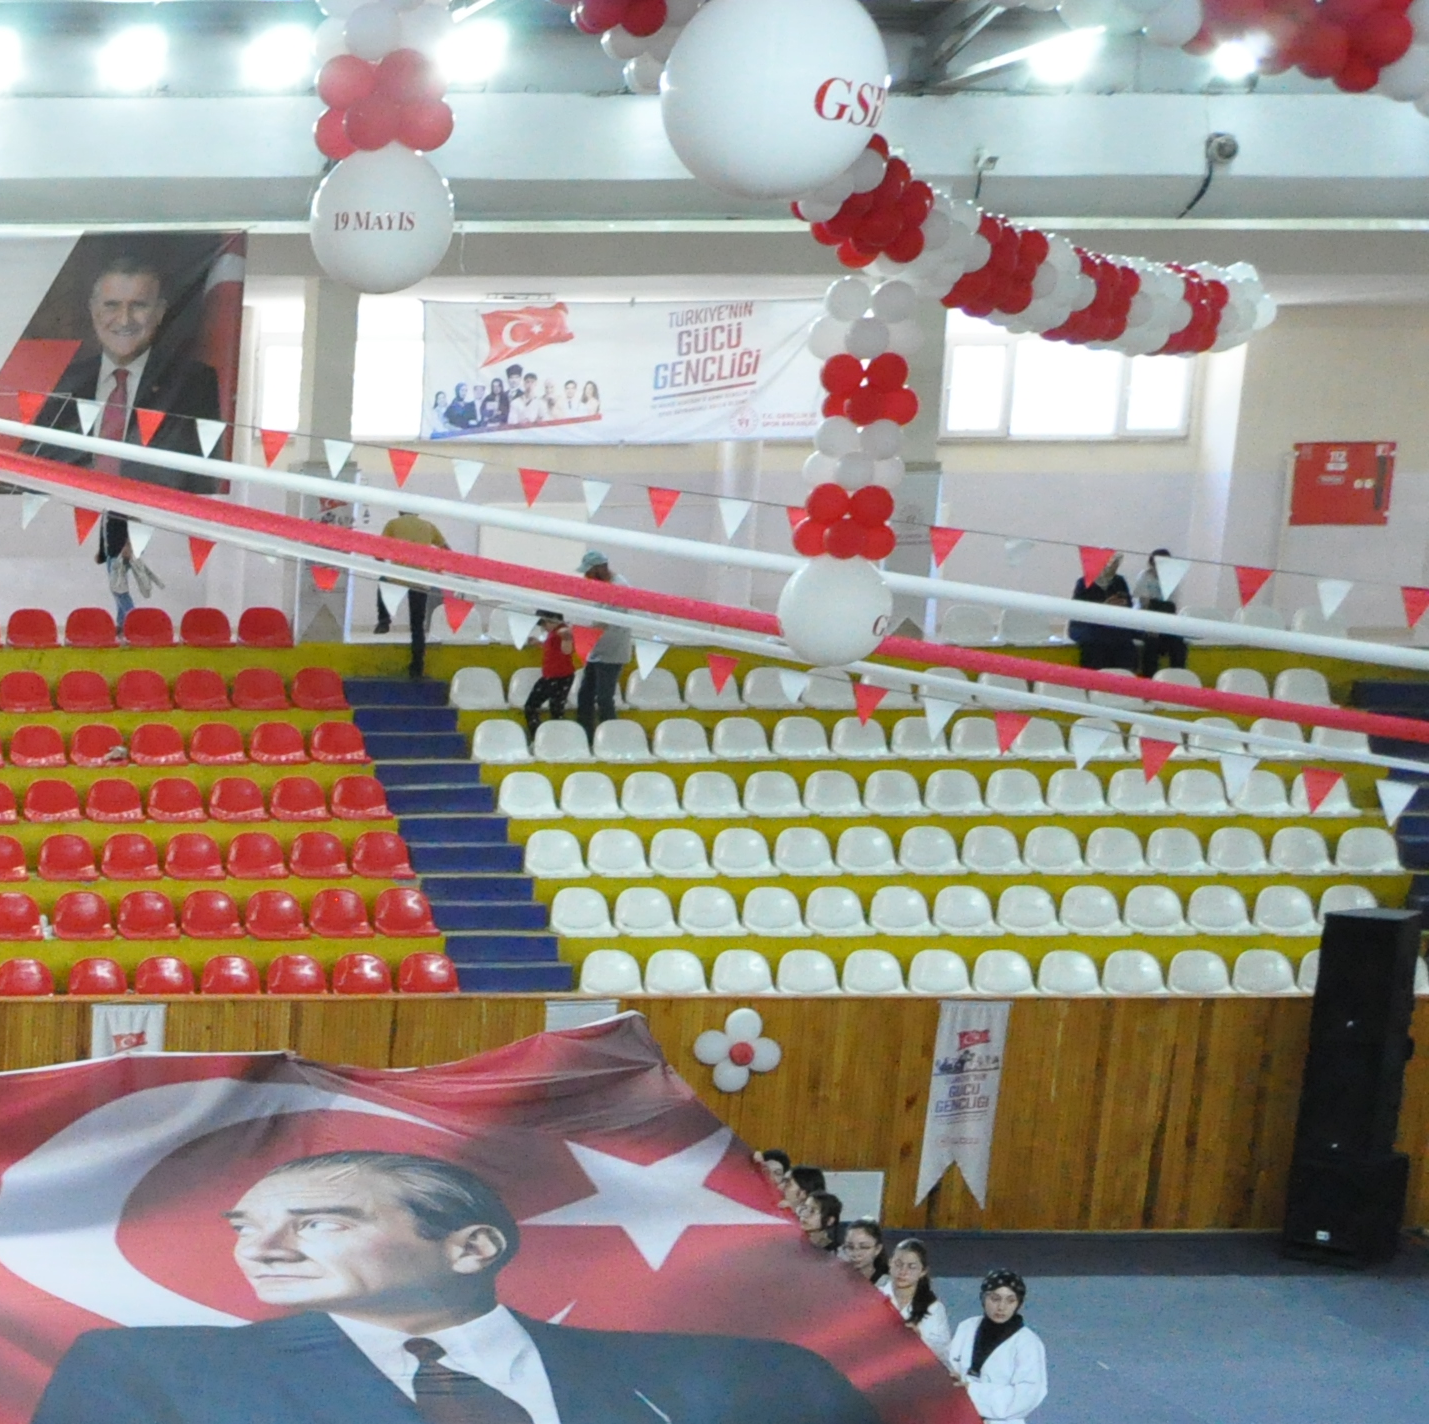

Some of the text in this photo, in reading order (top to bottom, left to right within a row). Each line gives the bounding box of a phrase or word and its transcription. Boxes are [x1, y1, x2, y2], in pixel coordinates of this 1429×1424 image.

[334, 211, 415, 231] 19 MAYIS
[677, 321, 743, 357] GÜCÜ
[653, 347, 762, 390] GENÇLİĞİ
